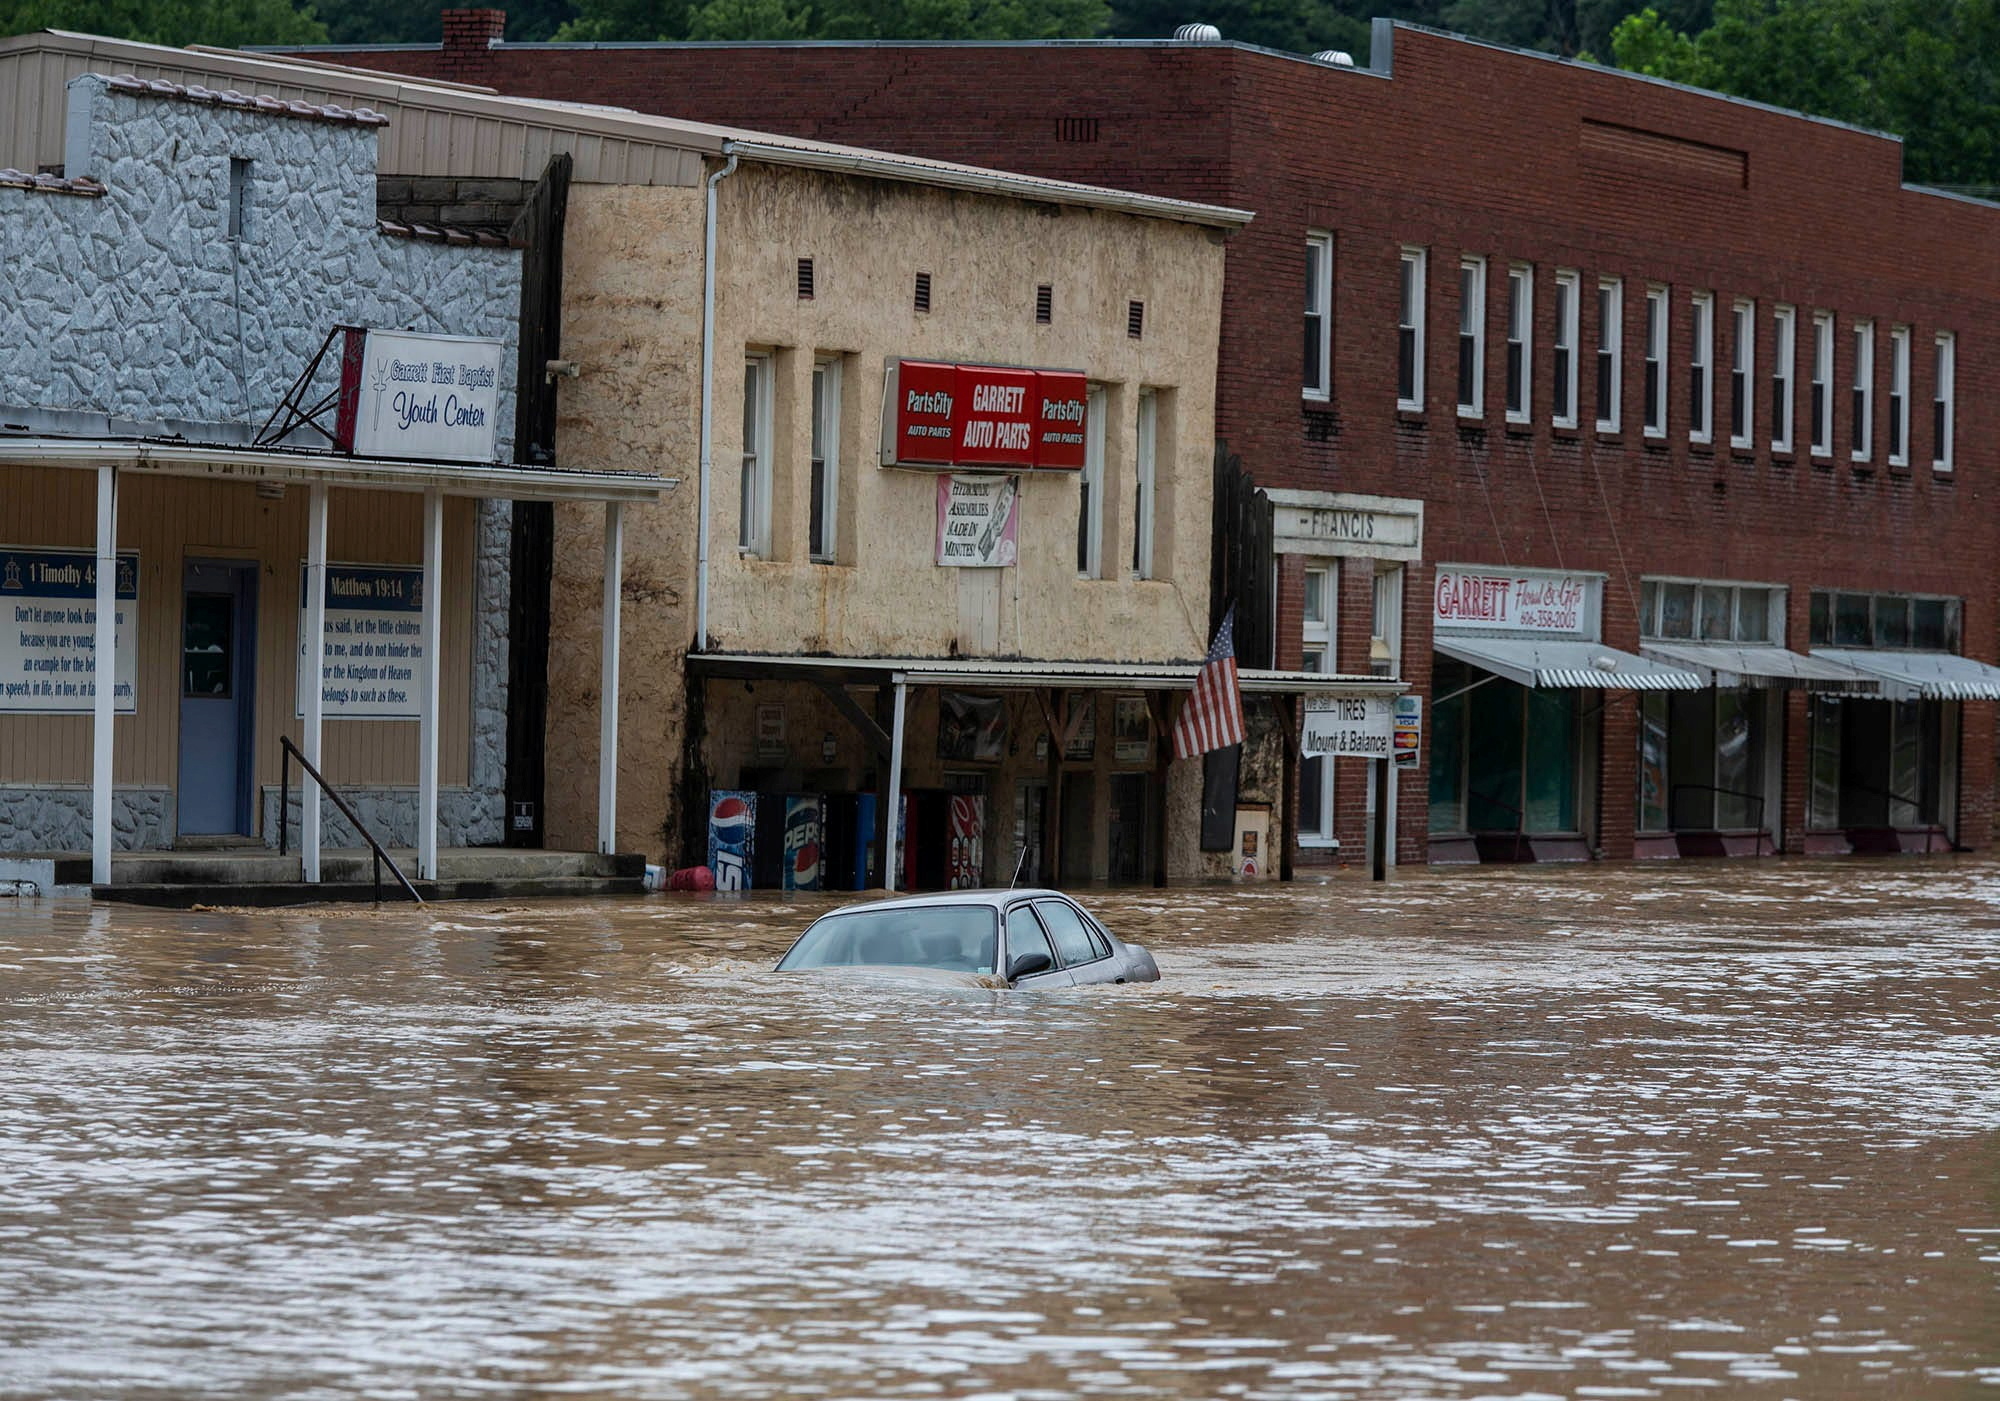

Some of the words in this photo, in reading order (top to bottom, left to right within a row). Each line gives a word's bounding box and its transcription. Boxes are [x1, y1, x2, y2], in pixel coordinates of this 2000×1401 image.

[391, 359, 428, 383] Garrett
[432, 362, 455, 384] First
[459, 364, 495, 391] Baptist
[907, 390, 953, 420] PartsCity
[973, 384, 1026, 414] GARRETT
[393, 391, 438, 430] Youth
[444, 394, 485, 427] Center
[1041, 398, 1085, 426] PartsCity
[907, 425, 926, 436] AUTO
[928, 425, 951, 438] PARTS
[963, 420, 993, 449] AUTO
[994, 422, 1031, 450] PARTS
[1042, 432, 1061, 443] AUTO
[1061, 433, 1083, 444] PARTS
[1312, 510, 1374, 539] FRANCIS
[29, 563, 36, 583] 1
[40, 563, 82, 588] Timothy
[331, 576, 372, 597] Matthew
[375, 578, 403, 598] 19:14
[1437, 573, 1511, 621] GARRETT
[15, 606, 33, 623] Don't
[34, 607, 42, 623] let
[43, 609, 65, 628] anyone
[67, 607, 83, 624] look
[335, 618, 353, 636] said,
[355, 619, 364, 634] let
[366, 619, 377, 634] the
[378, 619, 393, 635] little
[394, 619, 421, 636] children
[20, 630, 45, 647] because
[46, 635, 57, 650] you
[59, 635, 71, 647] are
[325, 641, 332, 657] to
[349, 641, 362, 657] and
[365, 641, 374, 657] do
[374, 643, 387, 657] not
[387, 641, 410, 659] hinder
[23, 658, 32, 671] an
[34, 656, 60, 675] example
[61, 656, 71, 672] for
[73, 656, 84, 672] the
[333, 664, 345, 680] the
[346, 664, 378, 683] Kingdom
[380, 664, 387, 680] of
[387, 665, 412, 681] Heaven
[6, 680, 31, 698] speech,
[33, 680, 40, 696] in
[55, 680, 62, 696] in
[79, 680, 87, 696] in
[351, 688, 358, 703] to
[359, 689, 377, 703] such
[378, 691, 386, 703] as
[387, 689, 408, 705] these.
[1337, 698, 1366, 721] TIRES
[1307, 730, 1338, 752] Mount
[1339, 732, 1347, 751] &
[1349, 730, 1387, 752] Balance
[784, 822, 820, 855] PEPS
